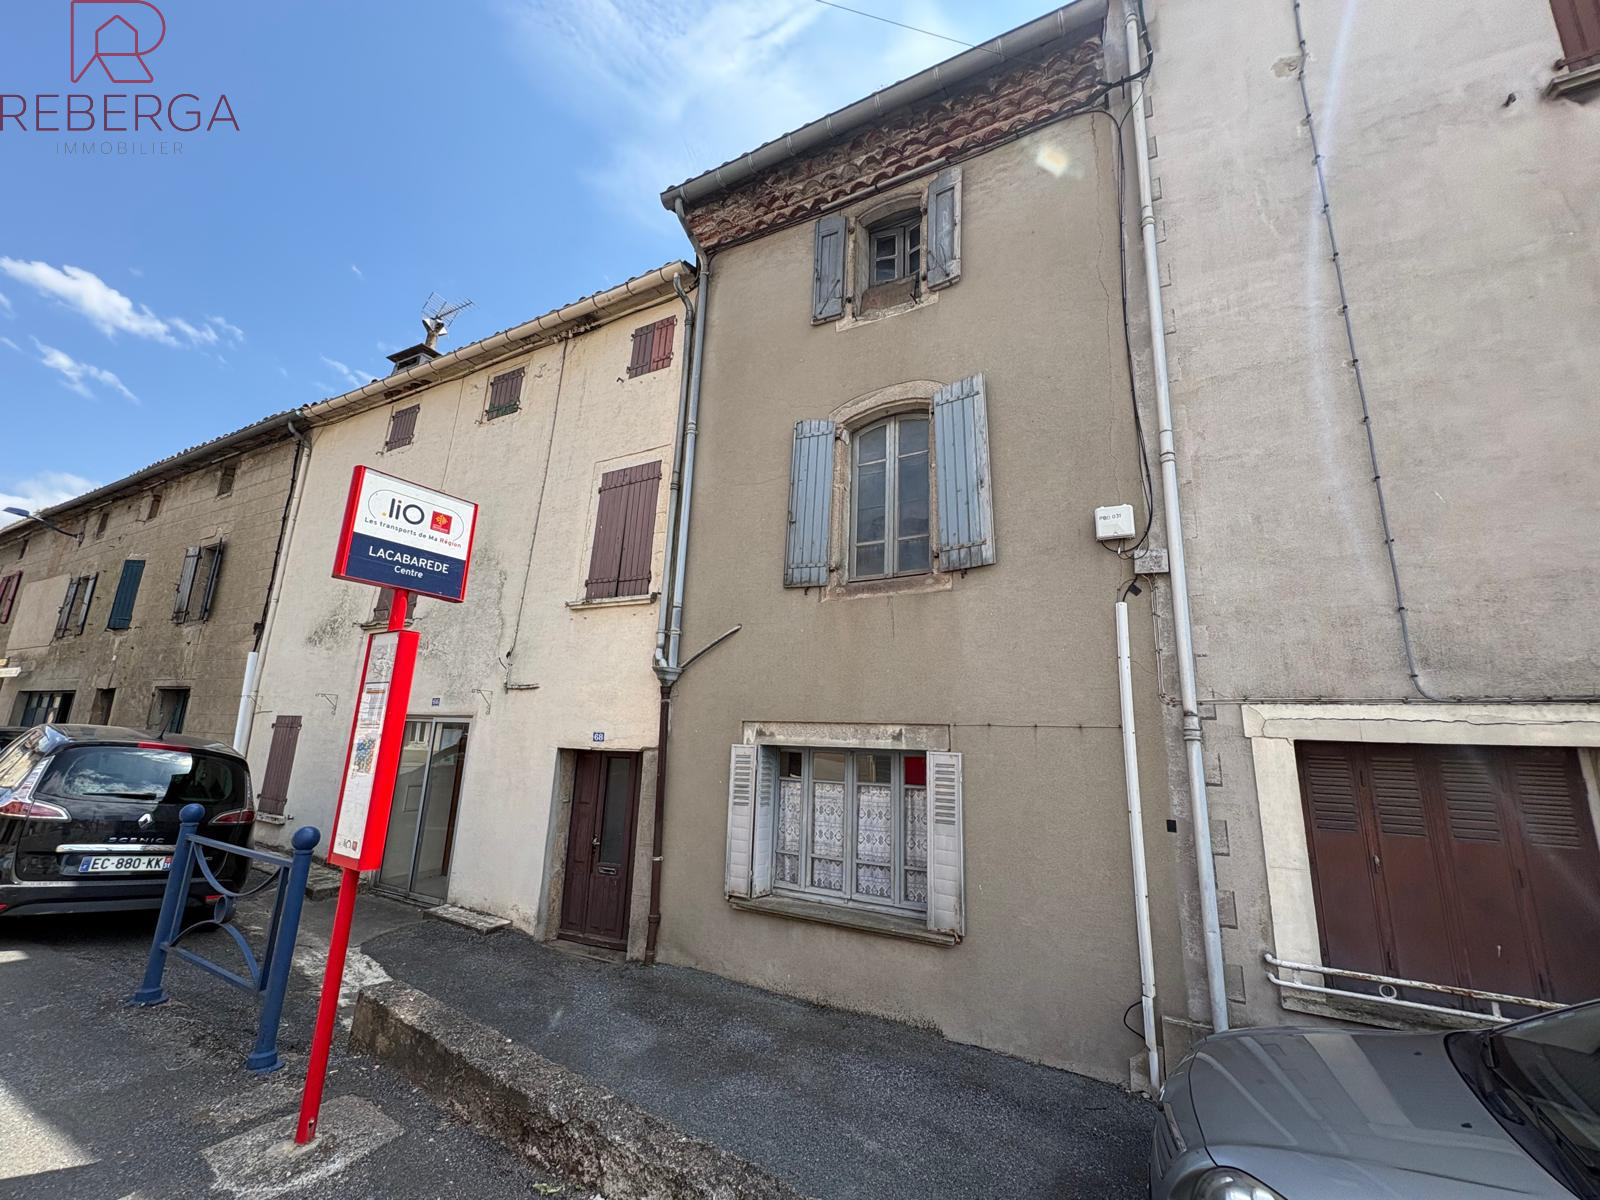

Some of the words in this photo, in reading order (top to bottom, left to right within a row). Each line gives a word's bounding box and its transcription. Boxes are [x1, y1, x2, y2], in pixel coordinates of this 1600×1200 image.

[364, 517, 378, 526] Les
[379, 521, 417, 537] transports
[428, 534, 438, 542] Ma
[368, 545, 450, 575] LACABAREDE
[394, 565, 424, 579] Centre
[91, 857, 164, 870] EC-880-KK
